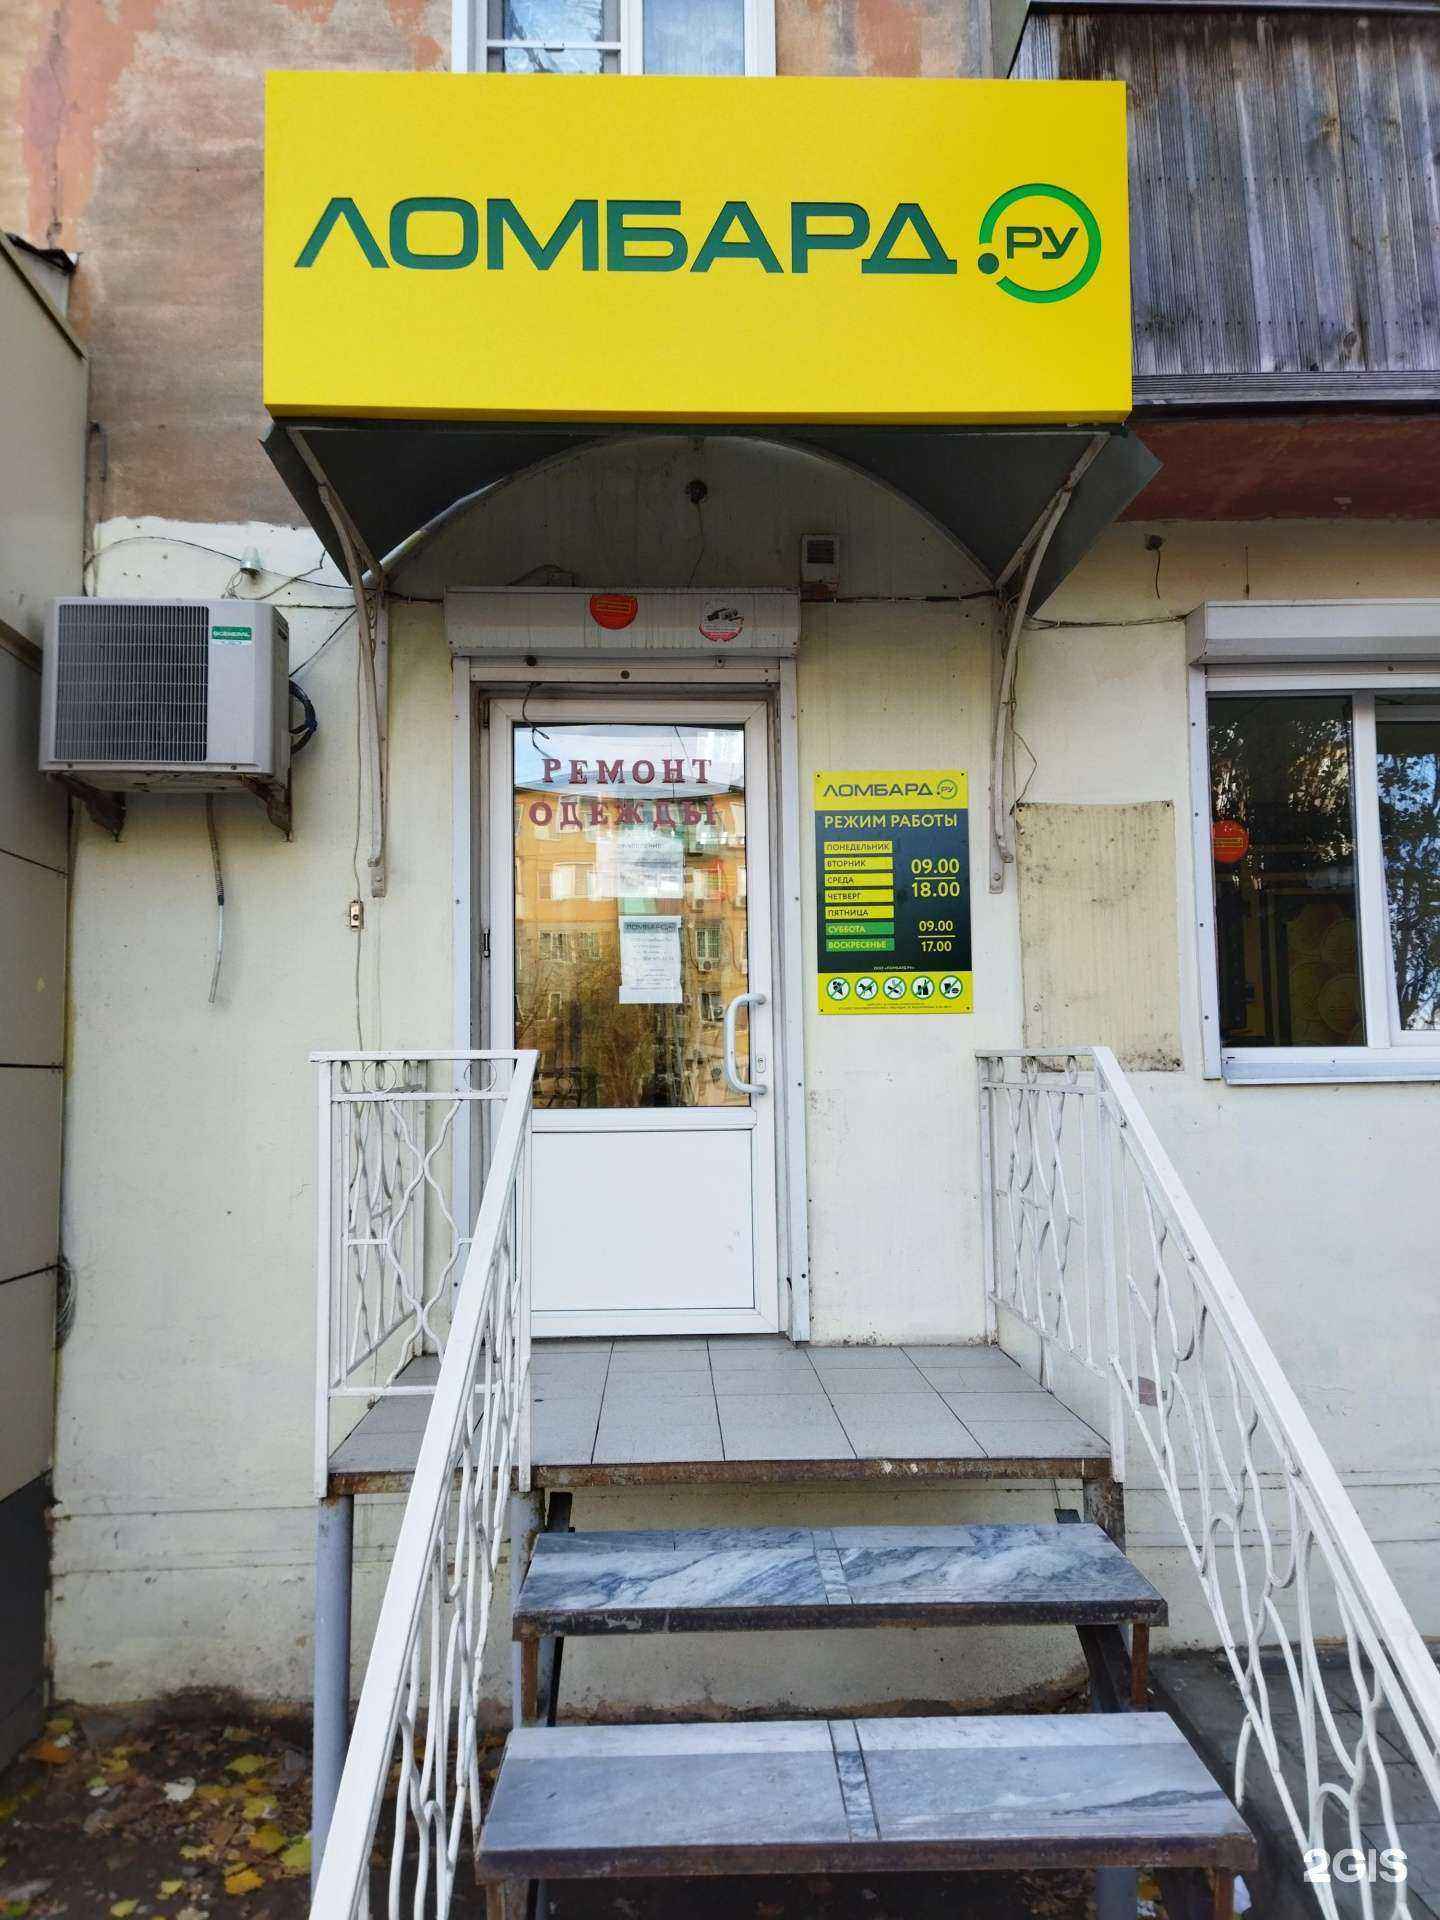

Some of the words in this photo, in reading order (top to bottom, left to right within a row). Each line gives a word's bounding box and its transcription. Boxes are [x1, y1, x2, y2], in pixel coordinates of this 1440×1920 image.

[295, 196, 958, 275] ЛОМБАРД
[541, 757, 712, 784] РЕМОНТ
[823, 784, 933, 797] ЛОМБАРД
[528, 801, 716, 830] ОДЕЖДЫ
[824, 814, 887, 829] РЕЖИМ
[891, 813, 957, 828] РАБОТЫ
[826, 843, 889, 852] ПОНЕДЕЛЬНИК
[827, 860, 866, 868] ВТОРНИК
[911, 858, 960, 874] 09.00
[827, 876, 854, 884] СРЕДА
[911, 881, 960, 897] 18.00
[828, 909, 869, 917] ПЯТНИЦА
[919, 920, 954, 932] 09.00
[828, 941, 887, 949] ВОСКРЕСЕНЬЕ
[920, 940, 952, 952] 17.00
